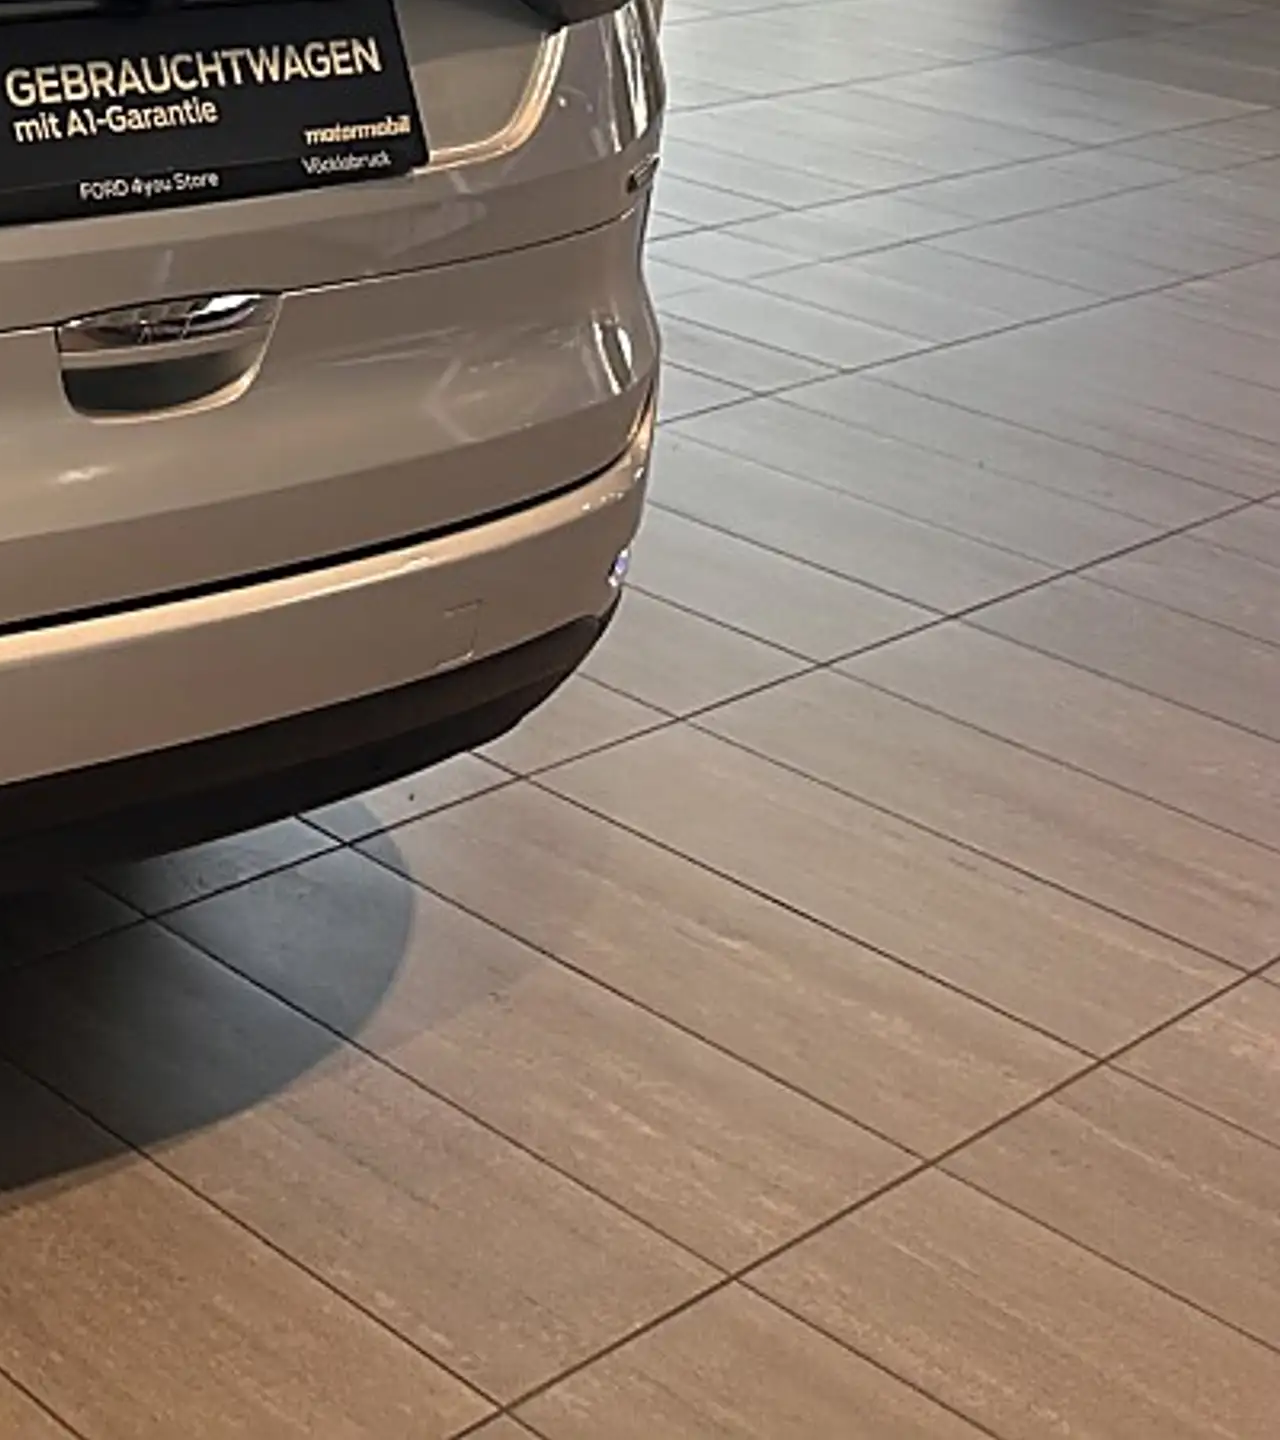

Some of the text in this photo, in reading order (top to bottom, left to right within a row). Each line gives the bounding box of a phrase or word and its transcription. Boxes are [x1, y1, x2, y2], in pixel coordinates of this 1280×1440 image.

[5, 36, 383, 107] GEBRAUCHTWAGEN
[13, 111, 63, 143] mit
[79, 179, 130, 201] FORD
[173, 171, 220, 192] Store
